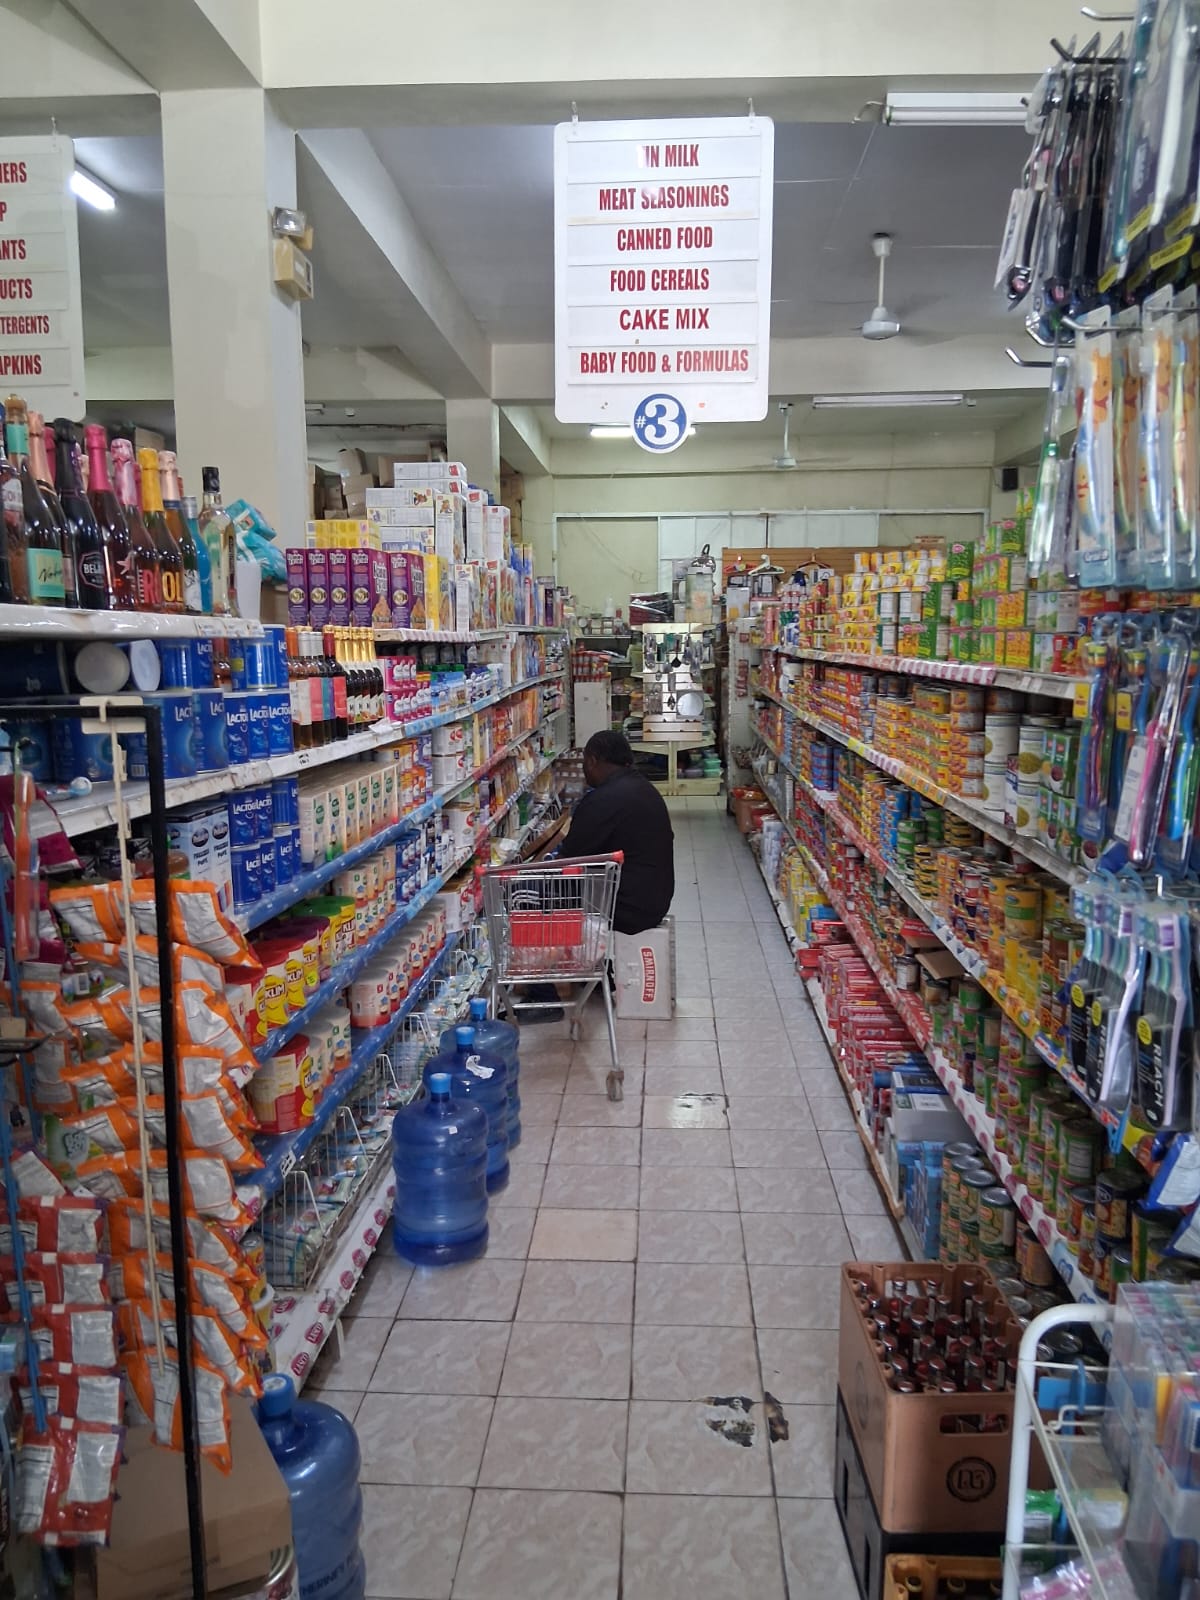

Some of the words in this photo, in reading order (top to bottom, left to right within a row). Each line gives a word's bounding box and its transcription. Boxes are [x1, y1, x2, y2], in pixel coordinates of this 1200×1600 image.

[665, 143, 699, 168] MILK
[0, 161, 27, 184] ERS
[599, 187, 636, 211] MEAT
[641, 184, 729, 210] SEASONINGS
[0, 238, 26, 261] NTS
[617, 227, 672, 252] CANNED
[677, 226, 713, 250] FOOD
[610, 269, 646, 292] FOOD
[651, 268, 710, 291] CEREALS
[619, 308, 669, 331] CAKE
[675, 308, 710, 330] MIX
[580, 351, 616, 374] BABY
[621, 351, 656, 373] FOOD
[661, 354, 671, 373] &
[676, 349, 749, 373] FORMULAS
[642, 950, 656, 1000] SMIRNOFF
[265, 983, 285, 999] KLIM
[1153, 1043, 1164, 1107] REACH
